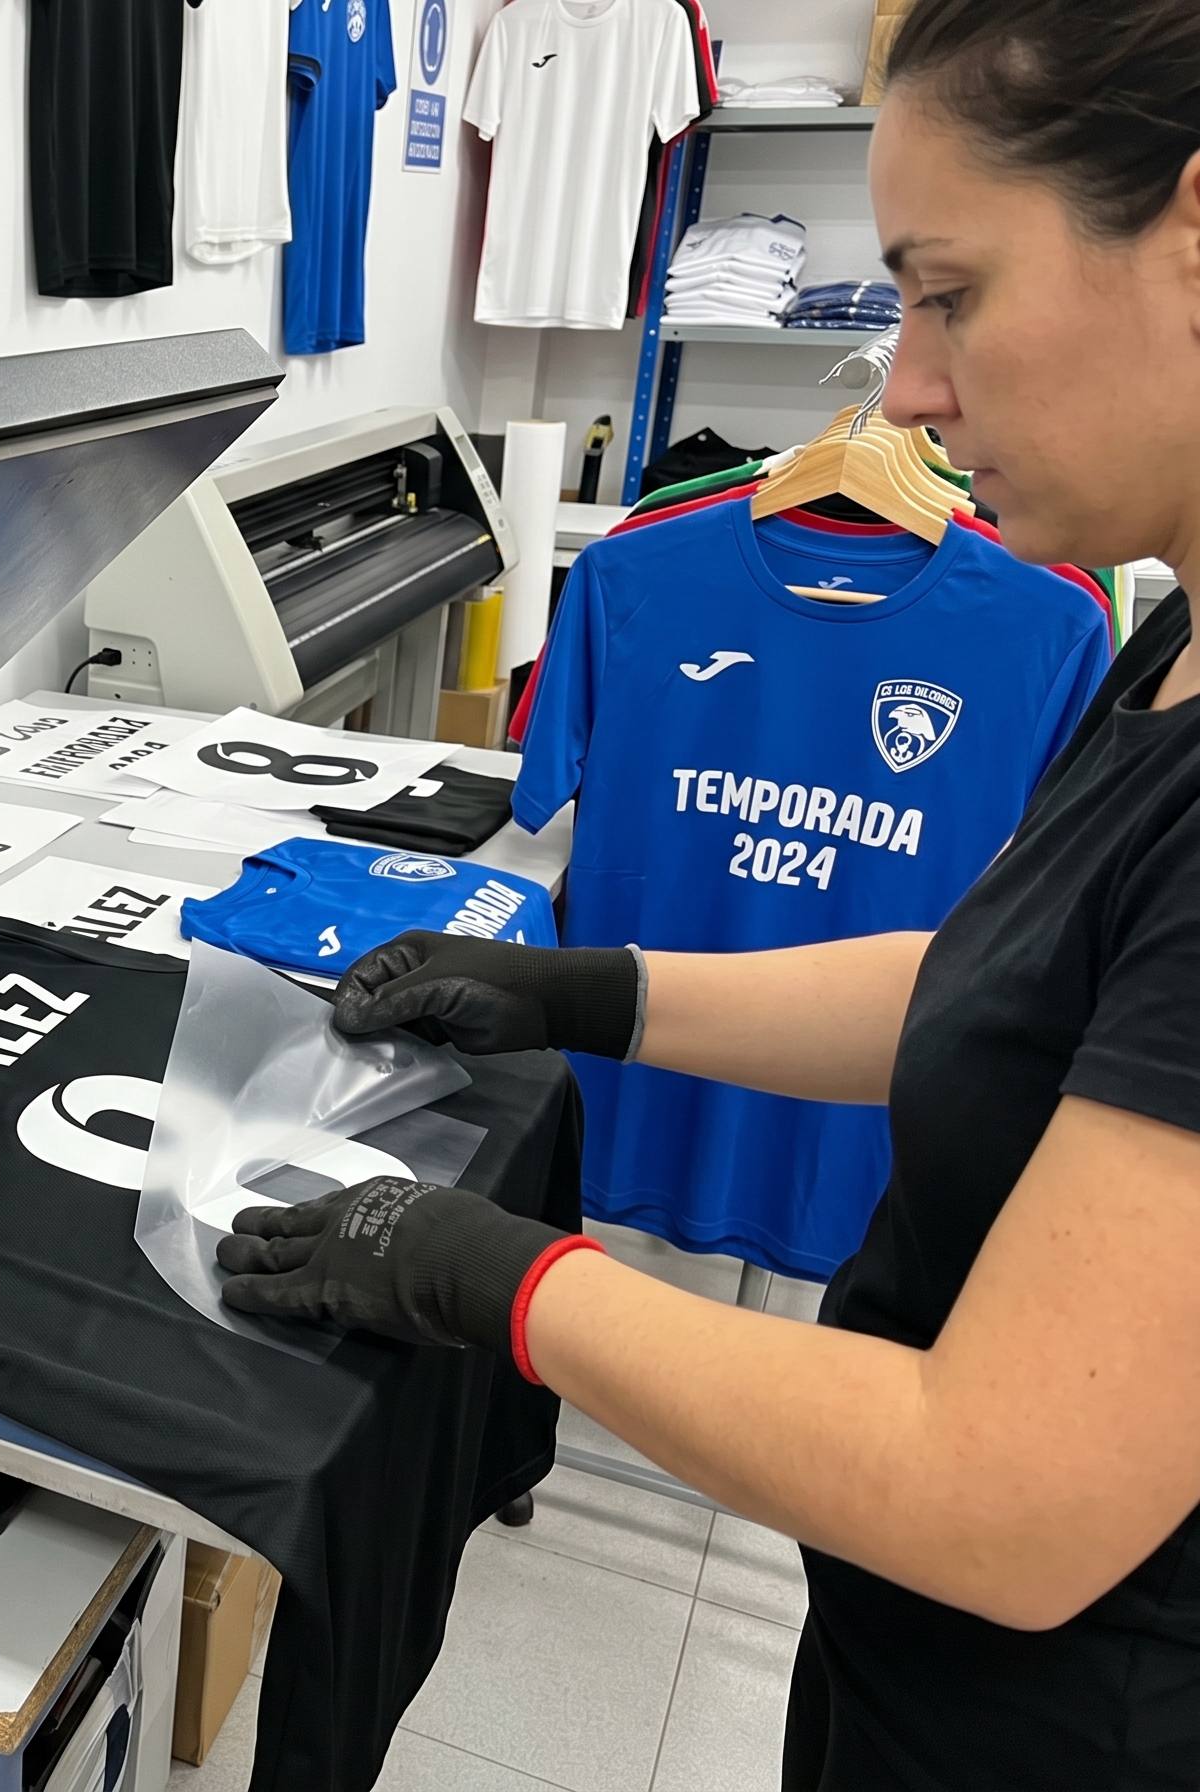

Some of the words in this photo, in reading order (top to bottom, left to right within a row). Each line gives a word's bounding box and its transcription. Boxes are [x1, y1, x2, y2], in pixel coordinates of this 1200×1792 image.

[198, 741, 379, 786] 8
[673, 769, 924, 856] TEMPORADA
[729, 833, 837, 890] 2024
[443, 880, 527, 940] ORADA
